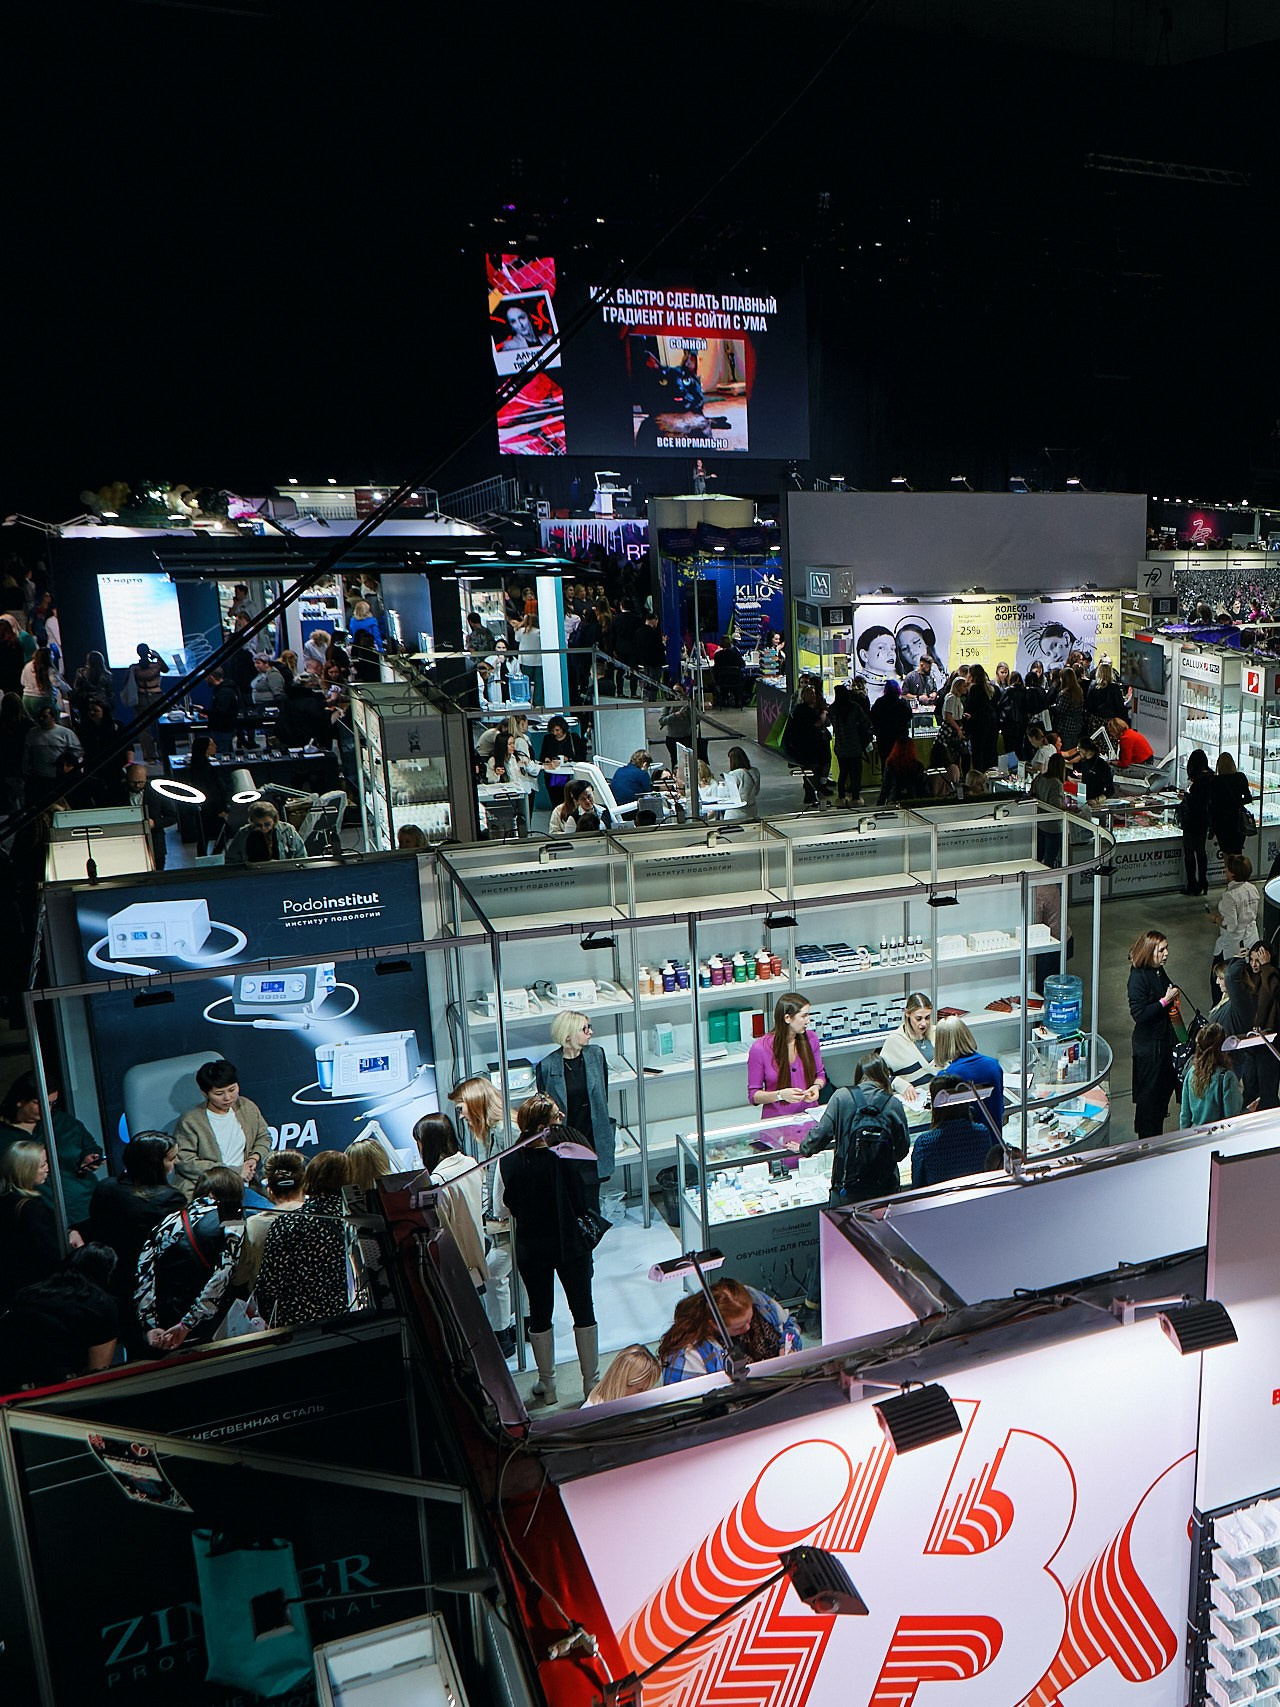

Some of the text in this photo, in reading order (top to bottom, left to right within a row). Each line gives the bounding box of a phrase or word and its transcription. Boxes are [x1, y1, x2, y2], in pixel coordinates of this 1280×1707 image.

[616, 288, 664, 306] БЫСТРО
[666, 292, 719, 311] СДЕЛАТЬ
[722, 295, 777, 314] ПЛАВНЫЙ
[602, 305, 768, 332] ГРАДИЕНТ И НЕ СОЙТИ С УМА
[656, 437, 728, 450] ВСЕ НОРМАЛЬНО
[814, 575, 828, 588] IVA
[994, 612, 1036, 620] ФОРТУНЫ
[996, 605, 1028, 614] КОЛЕСО
[956, 626, 981, 636] -25%
[996, 620, 1030, 628] МОМЕНТ
[996, 628, 1024, 636] УДАЧИ
[956, 648, 980, 657] -15%
[1182, 658, 1204, 670] CALLUX
[938, 834, 1009, 847] институт подологии
[798, 848, 877, 862] институт подологии
[1116, 850, 1182, 864] CALLUX PRO
[646, 864, 732, 878] институт подологии
[481, 879, 576, 894] институт подологии
[282, 892, 380, 914] Podoinstitut
[285, 912, 380, 928] институт подологии
[736, 1237, 820, 1260] ОБУЧЕНИЕ ДЛЯ ПОДО
[187, 1402, 326, 1442] ЧЕСТВЕННАЯ СТАЛЬ
[100, 1554, 381, 1666] ZINER
[106, 1596, 384, 1689] PROFNAL
